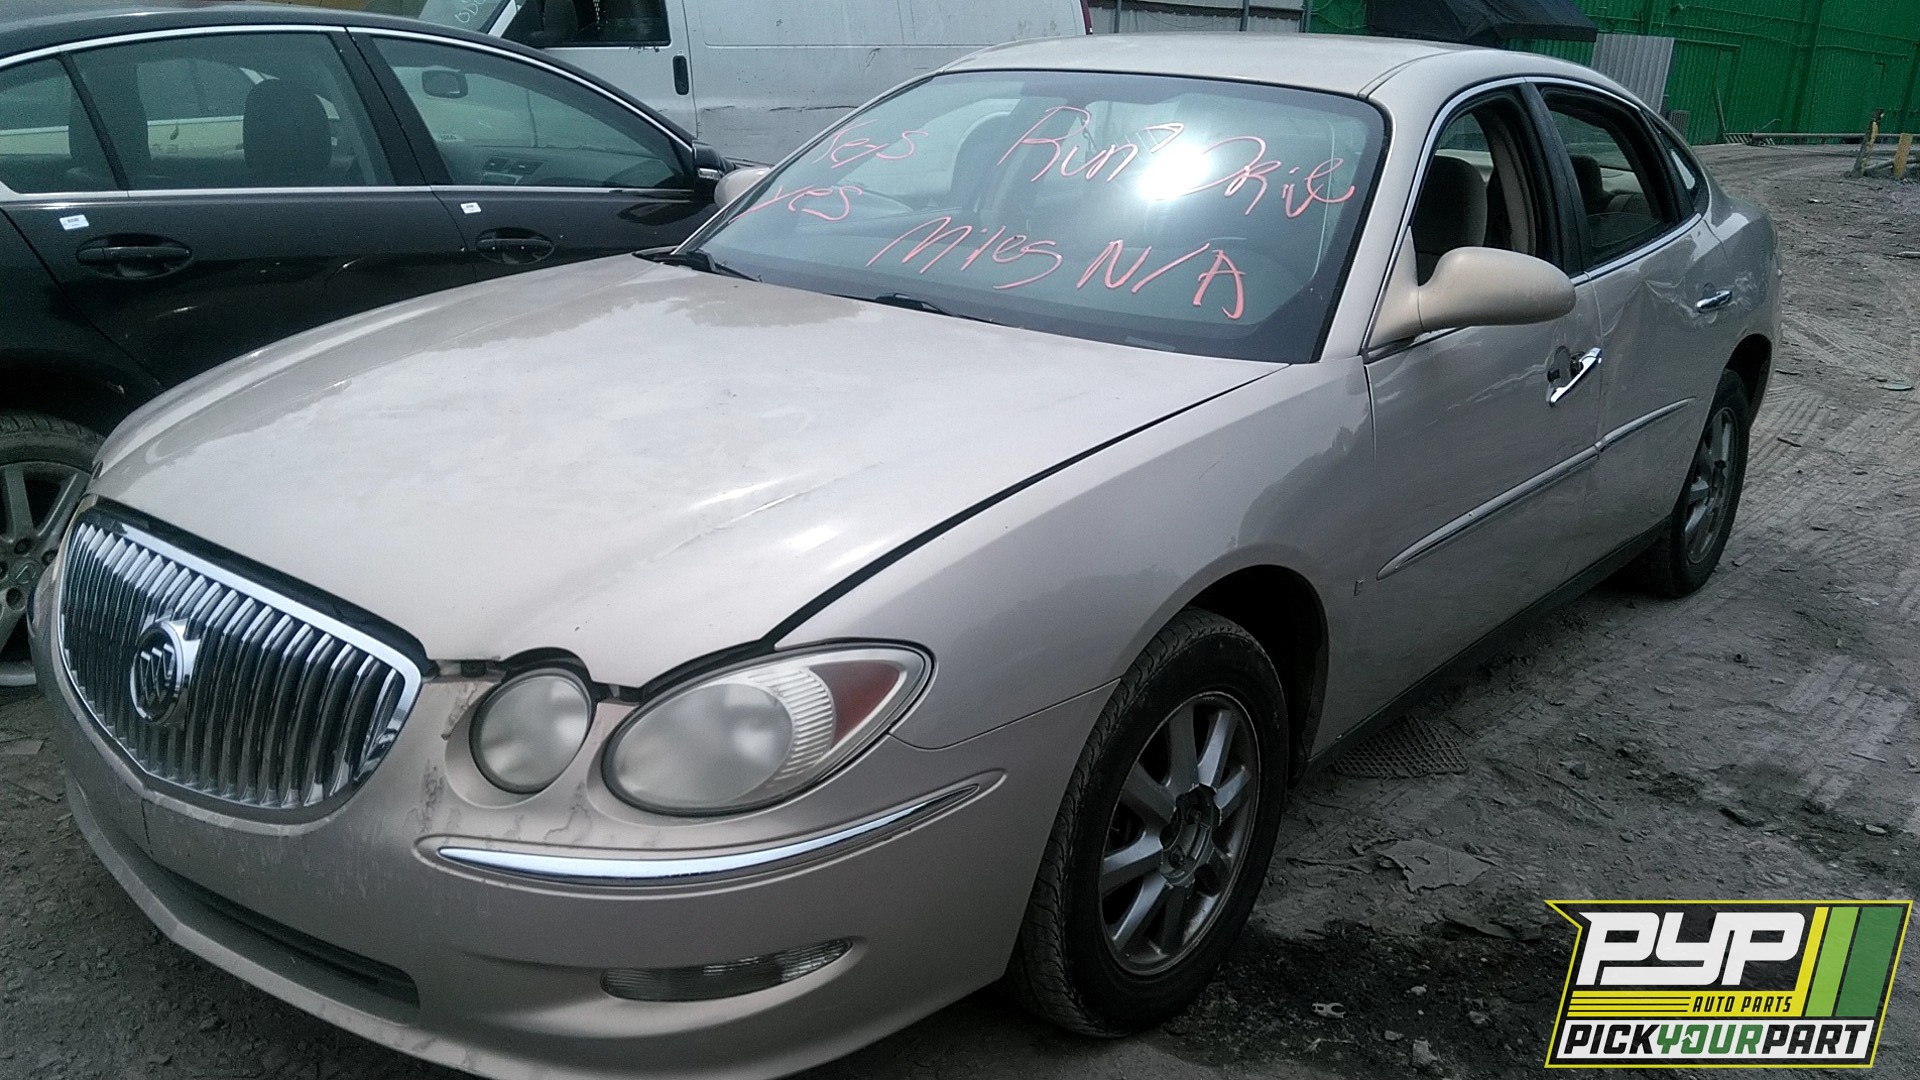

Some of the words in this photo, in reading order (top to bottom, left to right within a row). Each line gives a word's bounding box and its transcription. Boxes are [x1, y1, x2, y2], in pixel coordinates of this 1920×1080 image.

[997, 105, 1138, 183] Run
[865, 216, 1063, 290] Miles
[1076, 239, 1246, 319] N/A
